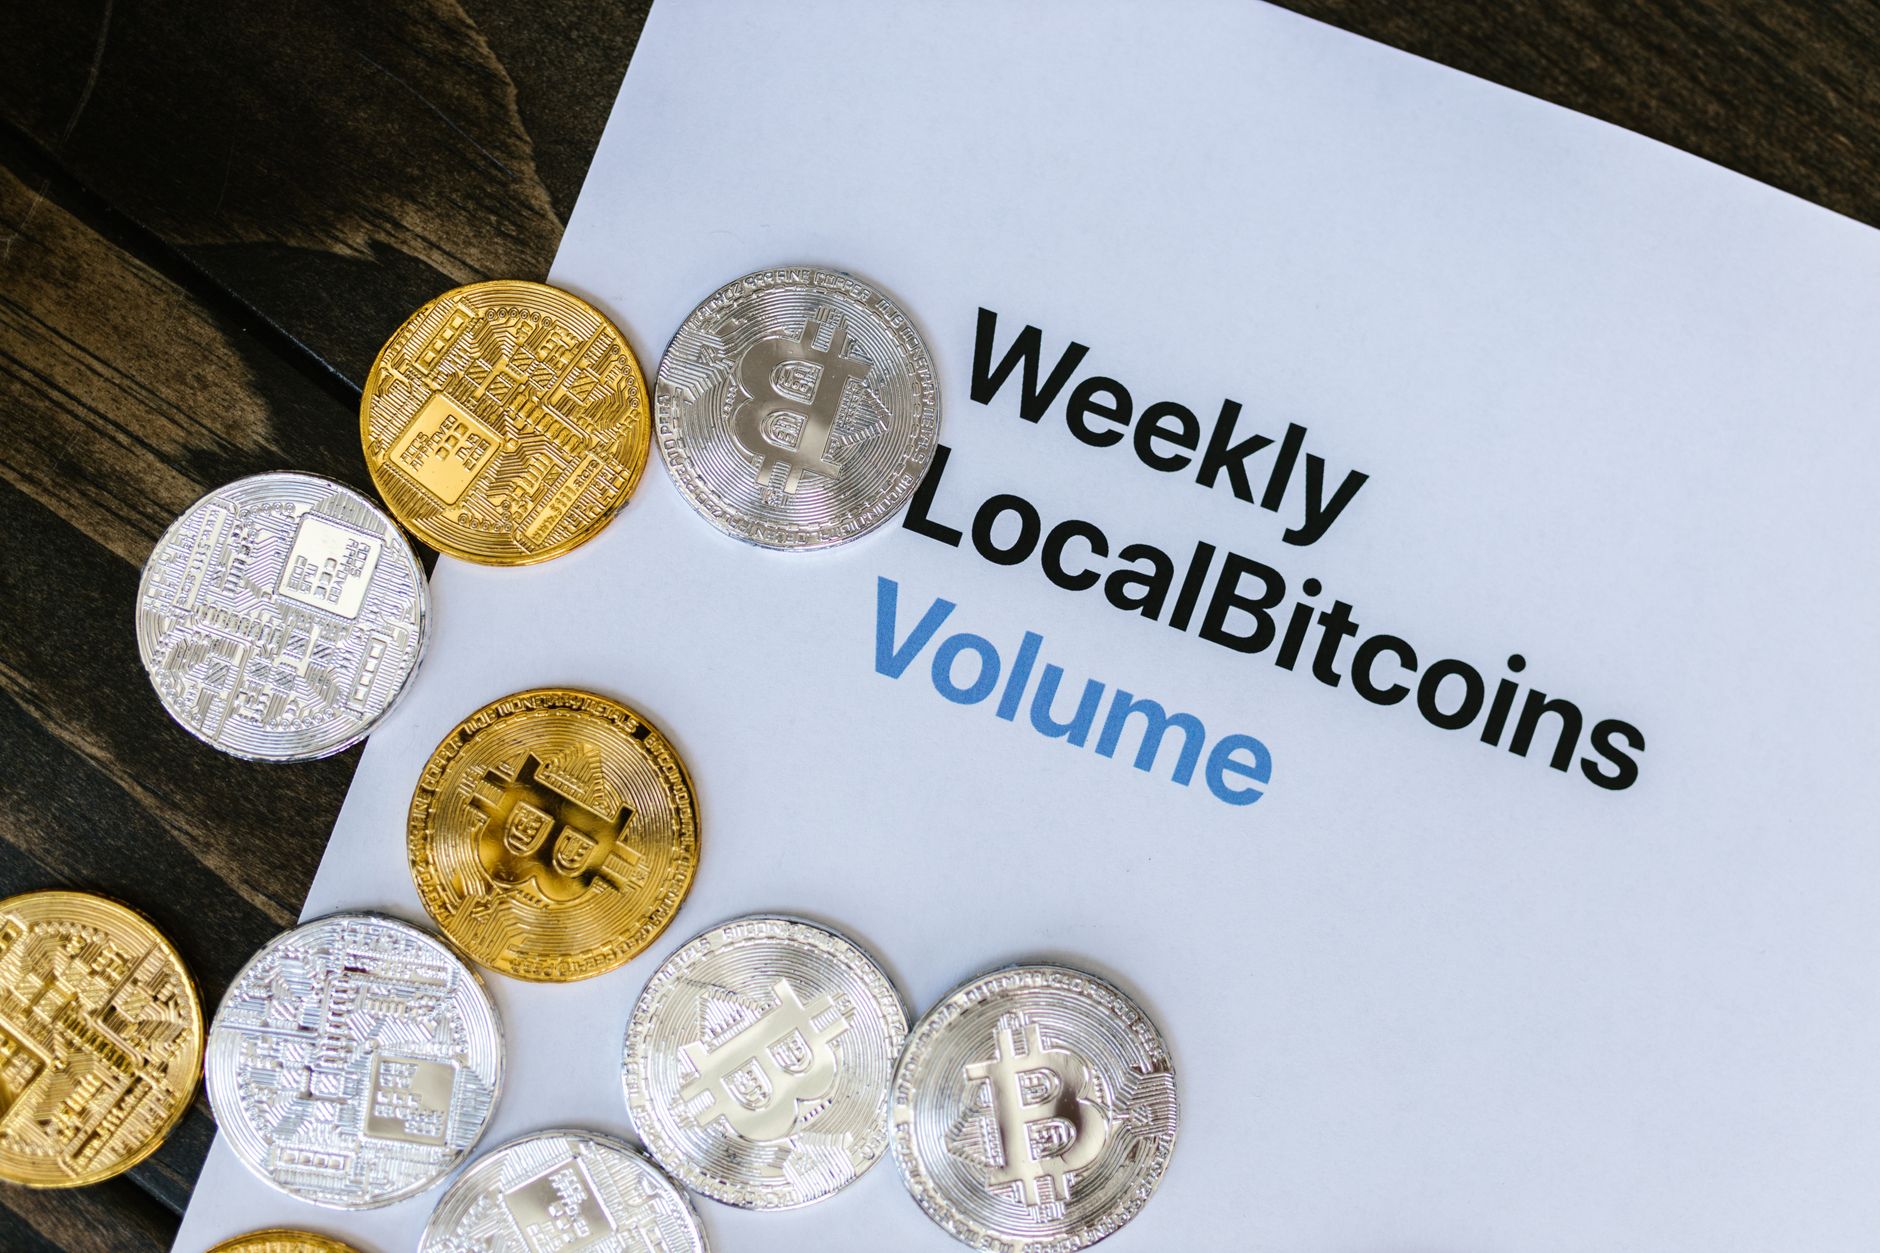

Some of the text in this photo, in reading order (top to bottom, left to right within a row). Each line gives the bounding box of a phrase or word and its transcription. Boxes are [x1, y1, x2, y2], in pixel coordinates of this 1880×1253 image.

[910, 407, 935, 465] METALS
[970, 307, 1369, 547] Weekly
[875, 576, 1273, 806] Volume
[902, 444, 1646, 792] LocalBitcoins
